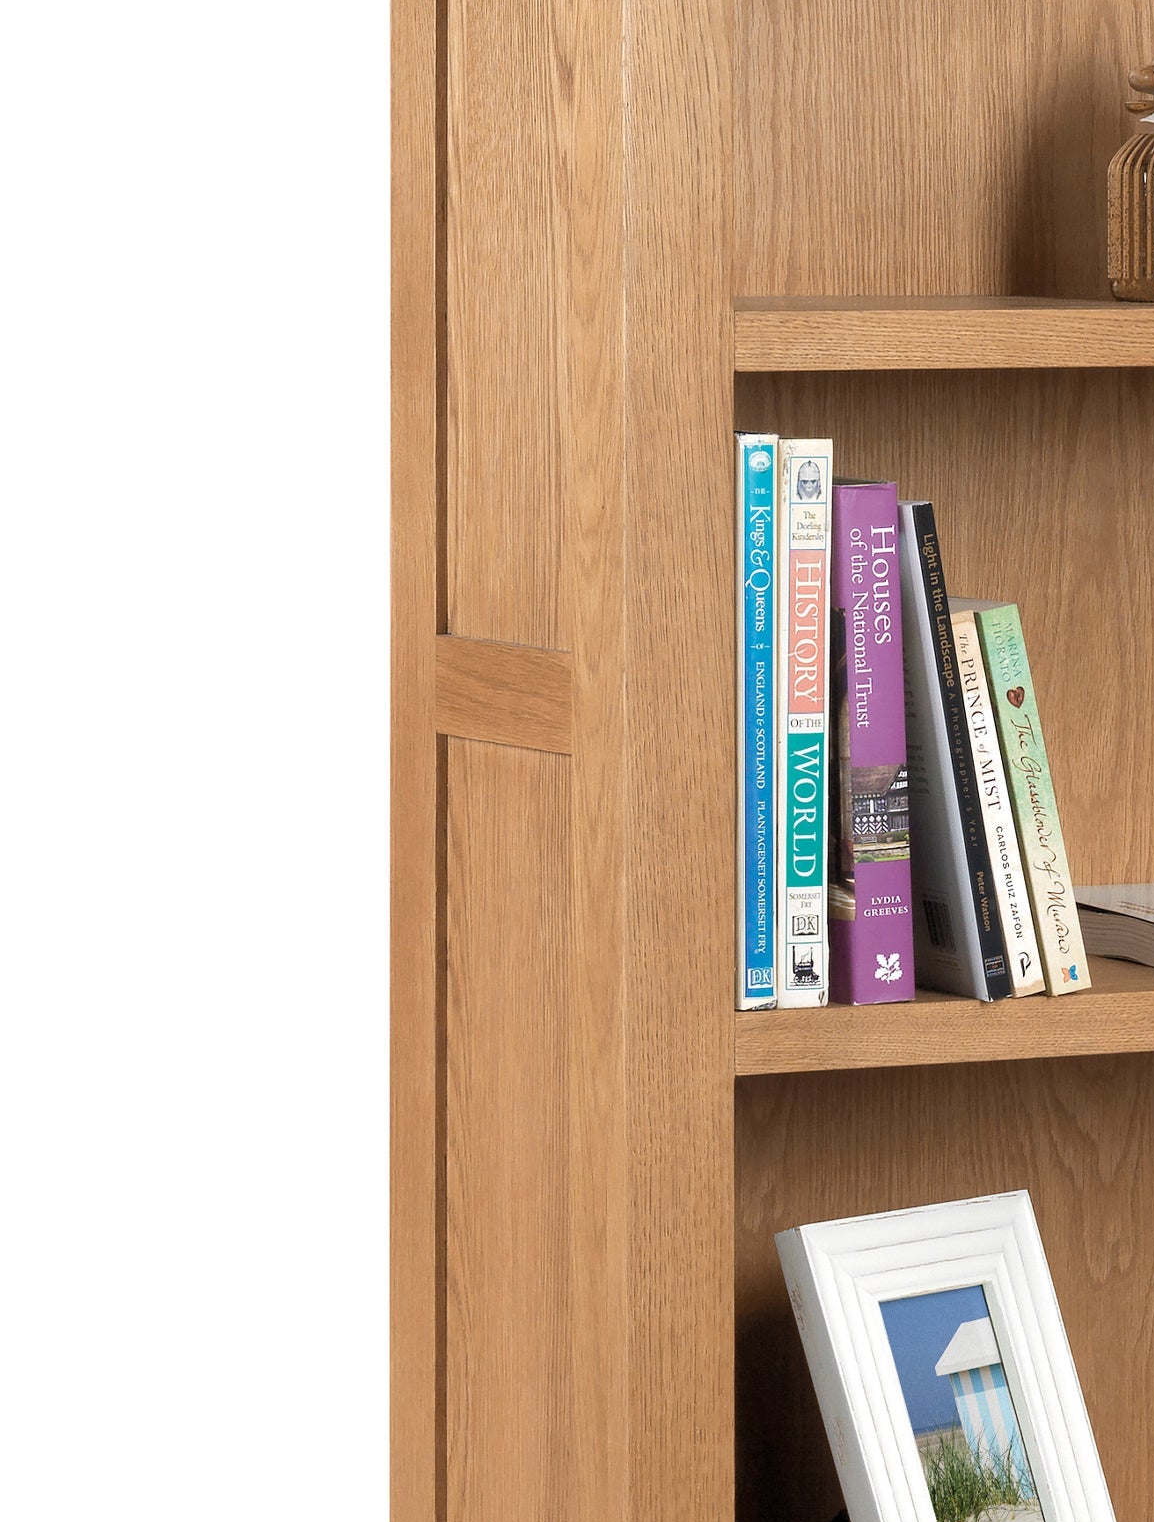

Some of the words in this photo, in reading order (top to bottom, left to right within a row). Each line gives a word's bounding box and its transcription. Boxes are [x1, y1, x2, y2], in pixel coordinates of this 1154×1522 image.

[749, 505, 771, 547] Kings
[803, 511, 816, 519] The
[850, 528, 868, 551] of
[923, 533, 938, 570] Light
[851, 554, 869, 584] the
[871, 525, 896, 645] Houses
[930, 571, 939, 586] in
[745, 568, 771, 632] Queens
[930, 588, 943, 612] the
[794, 559, 822, 704] HISTORY
[852, 591, 872, 675] National
[936, 614, 955, 687] Landscape
[958, 633, 968, 655] The
[992, 622, 1011, 683] FIORATO
[1005, 622, 1023, 678] MARINA
[755, 662, 765, 716] ENGLAND
[855, 677, 873, 728] Trust
[961, 657, 988, 739] PRINCE
[976, 743, 990, 755] of
[1011, 714, 1037, 751] The
[756, 728, 766, 789] SCOTLAND
[980, 759, 1002, 811] MIST
[793, 742, 820, 877] WORLD
[1012, 756, 1057, 862] Glassblower
[757, 801, 767, 876] PLANTAGENET
[976, 871, 987, 895] Peter
[995, 825, 1010, 870] CARLOS
[1004, 873, 1017, 899] RUIZ
[1033, 857, 1059, 882] of
[757, 878, 767, 931] SOMERSET
[796, 916, 816, 931] DK
[863, 906, 909, 918] GREEVES
[871, 895, 902, 906] LYDIA
[979, 897, 991, 932] Watson
[1046, 880, 1071, 954] Murano
[757, 934, 767, 953] FRY
[752, 968, 771, 984] DK
